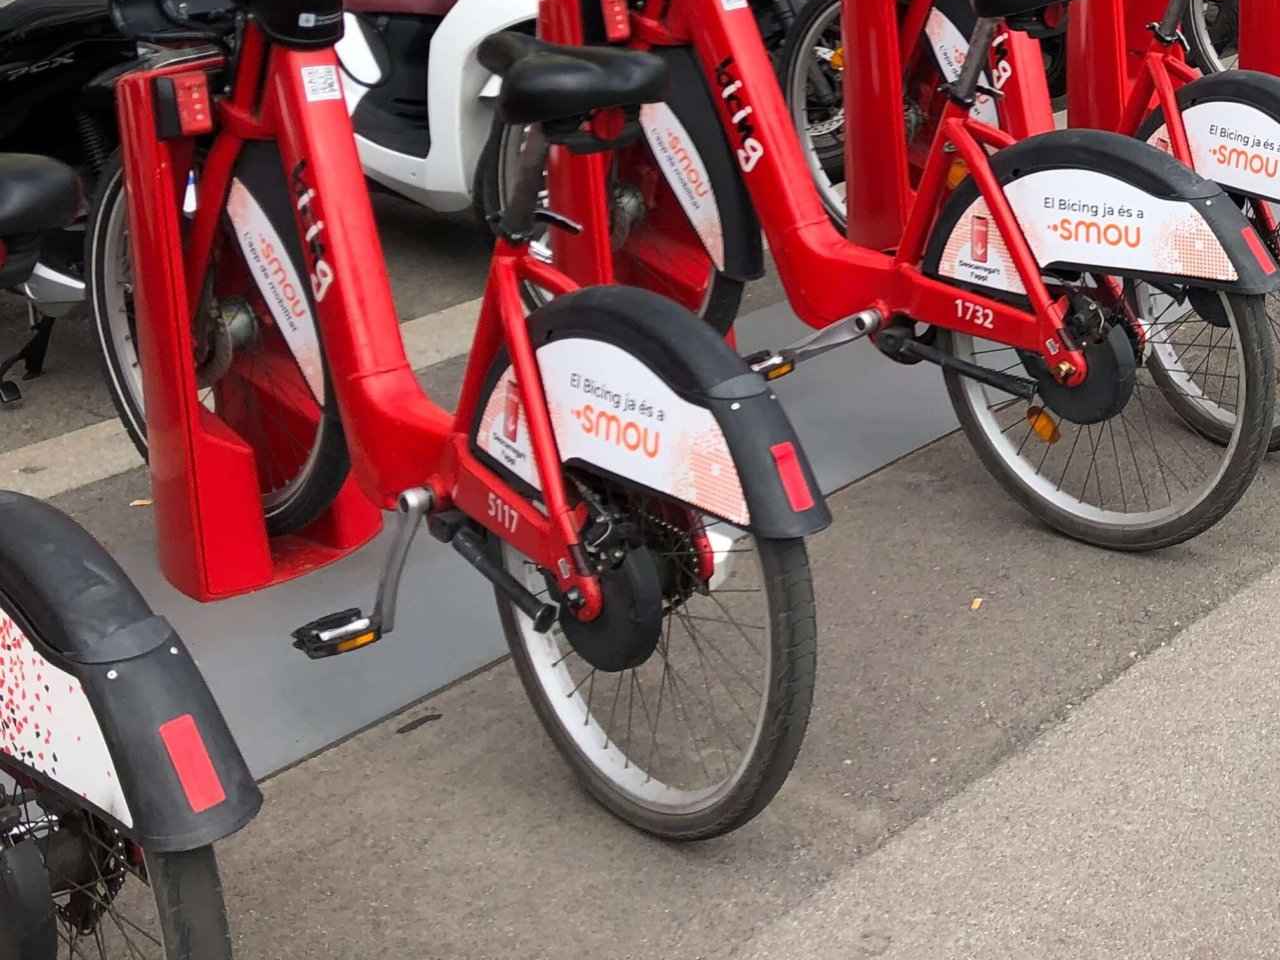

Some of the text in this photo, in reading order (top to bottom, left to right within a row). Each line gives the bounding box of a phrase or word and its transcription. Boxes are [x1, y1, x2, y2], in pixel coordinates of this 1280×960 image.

[716, 55, 764, 173] bicing
[1209, 124, 1218, 136] El
[1220, 127, 1250, 147] Bicing
[1251, 135, 1262, 148] ja
[1263, 138, 1275, 151] és
[666, 134, 710, 198] smou
[1216, 144, 1279, 178] smou
[1044, 196, 1144, 219] El Bicing ja és a
[1059, 218, 1142, 248] smou
[261, 242, 306, 318] smou
[954, 299, 994, 329] 1732
[570, 372, 667, 423] El Bicing ja és a
[580, 404, 661, 459] smou
[487, 493, 521, 534] 5117
